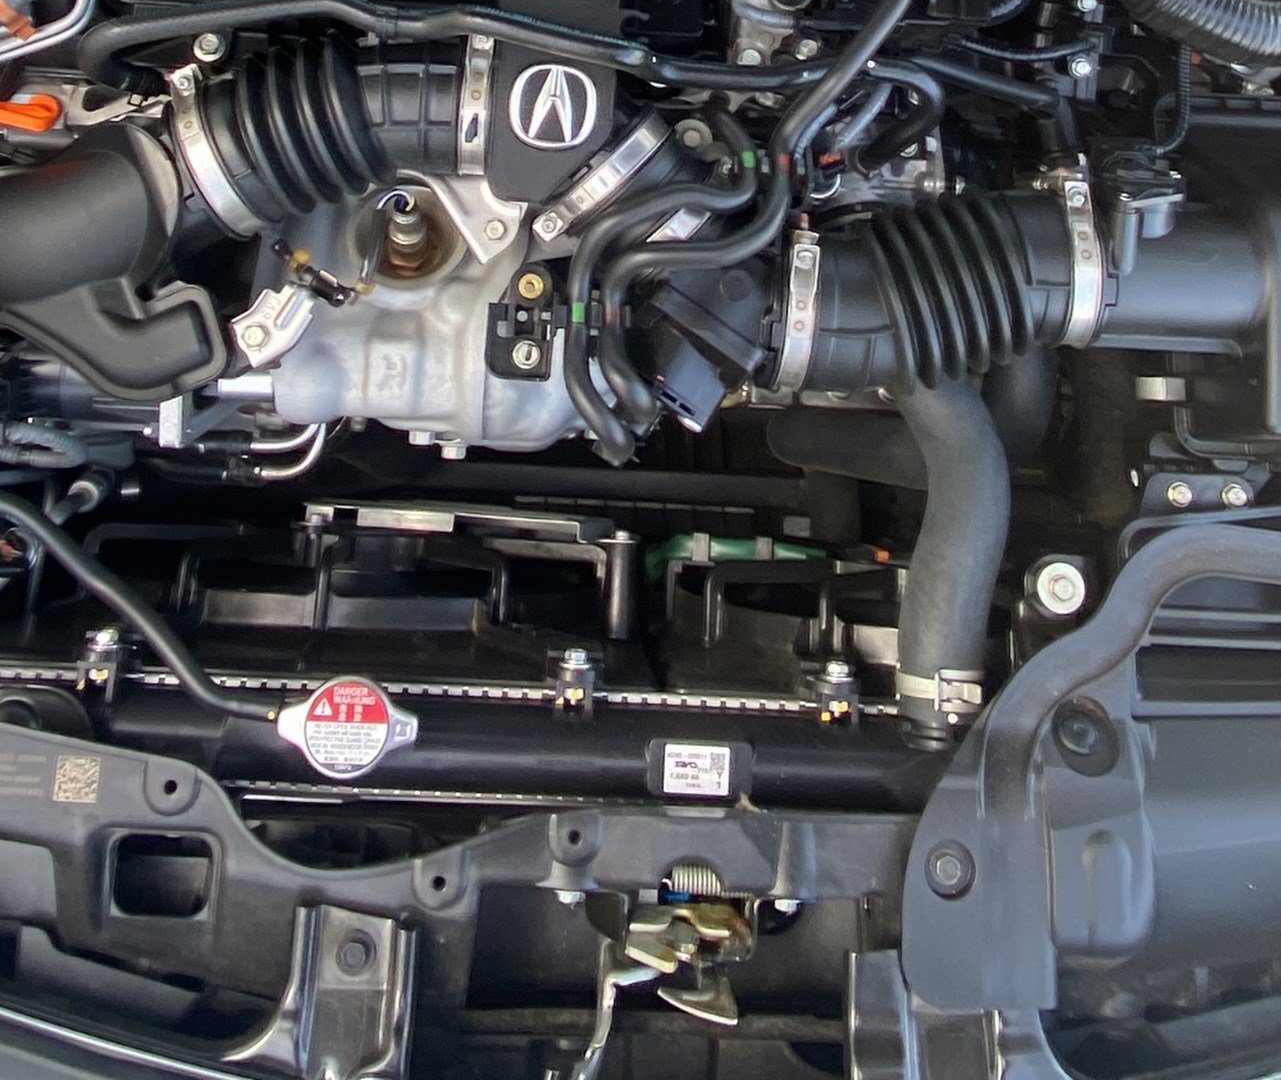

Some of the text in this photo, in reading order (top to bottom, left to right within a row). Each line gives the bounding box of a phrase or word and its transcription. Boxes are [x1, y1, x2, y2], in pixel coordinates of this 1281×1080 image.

[334, 687, 368, 695] DANGER
[334, 695, 376, 705] WARNING
[717, 771, 723, 780] Y
